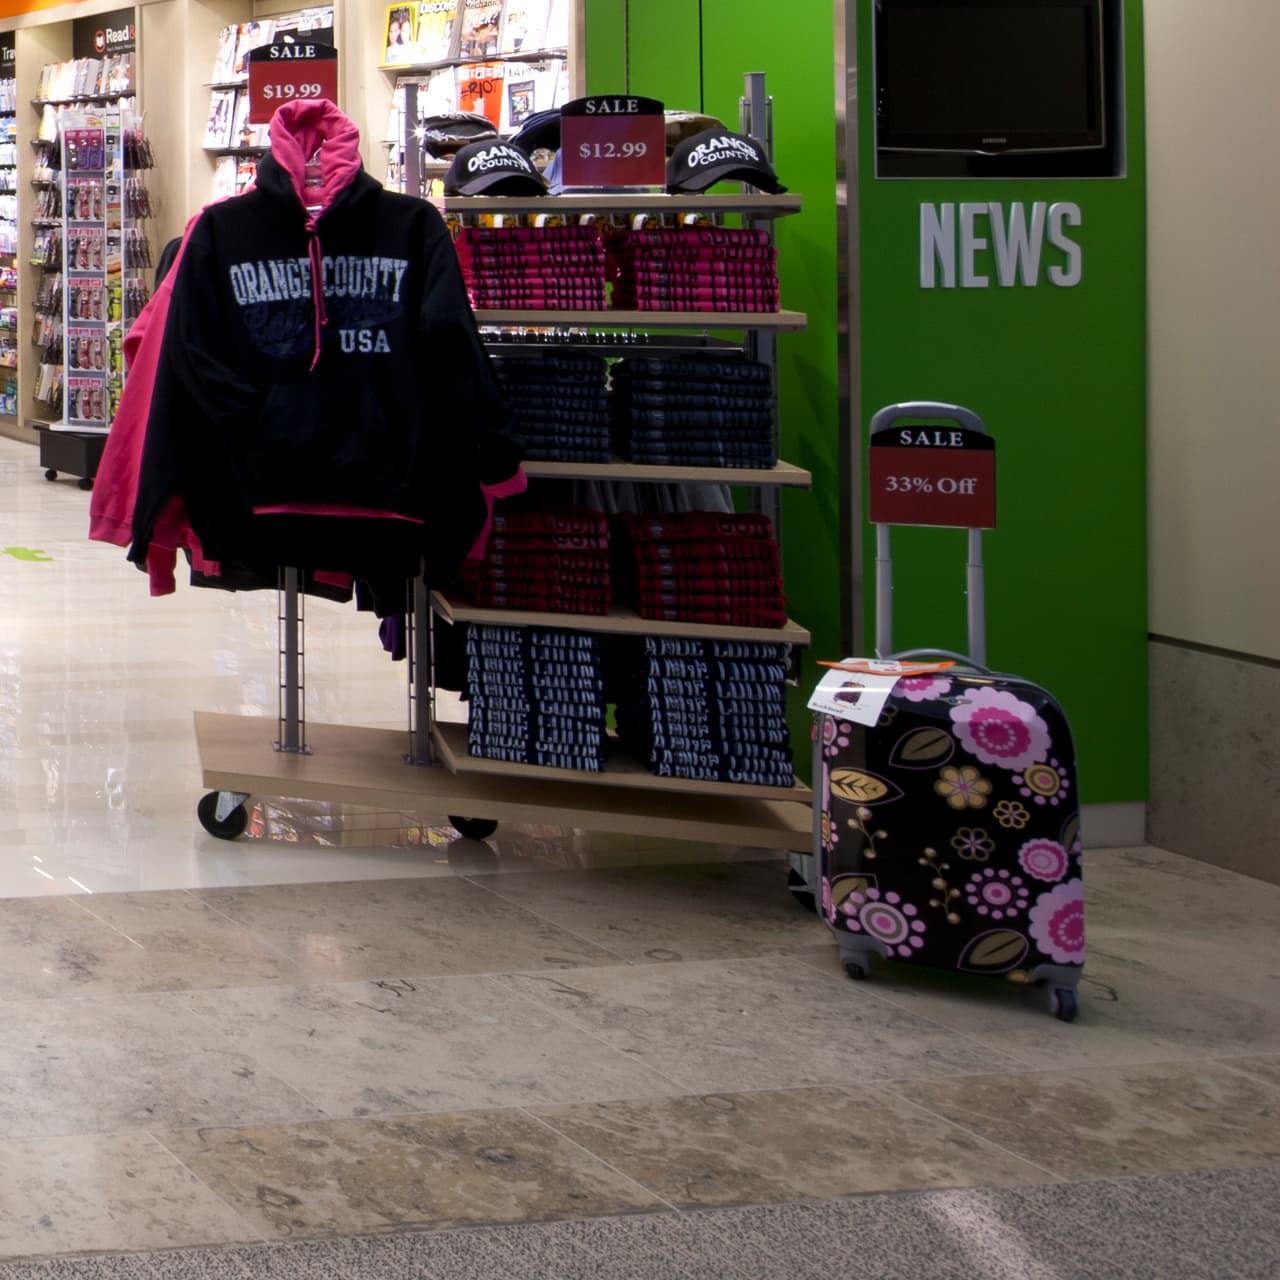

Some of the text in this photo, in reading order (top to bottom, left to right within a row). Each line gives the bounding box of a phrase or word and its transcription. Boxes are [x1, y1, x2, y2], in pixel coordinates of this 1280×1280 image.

[269, 45, 317, 59] SALE
[262, 83, 323, 100] $19.99
[585, 99, 639, 114] SALE
[579, 142, 648, 159] $12.99
[700, 150, 750, 165] COUNTY
[920, 202, 1082, 288] NEWS
[229, 256, 409, 306] ORANGE COUNTY
[338, 328, 392, 354] USA
[900, 429, 965, 448] SALE
[885, 475, 978, 496] 33% Off
